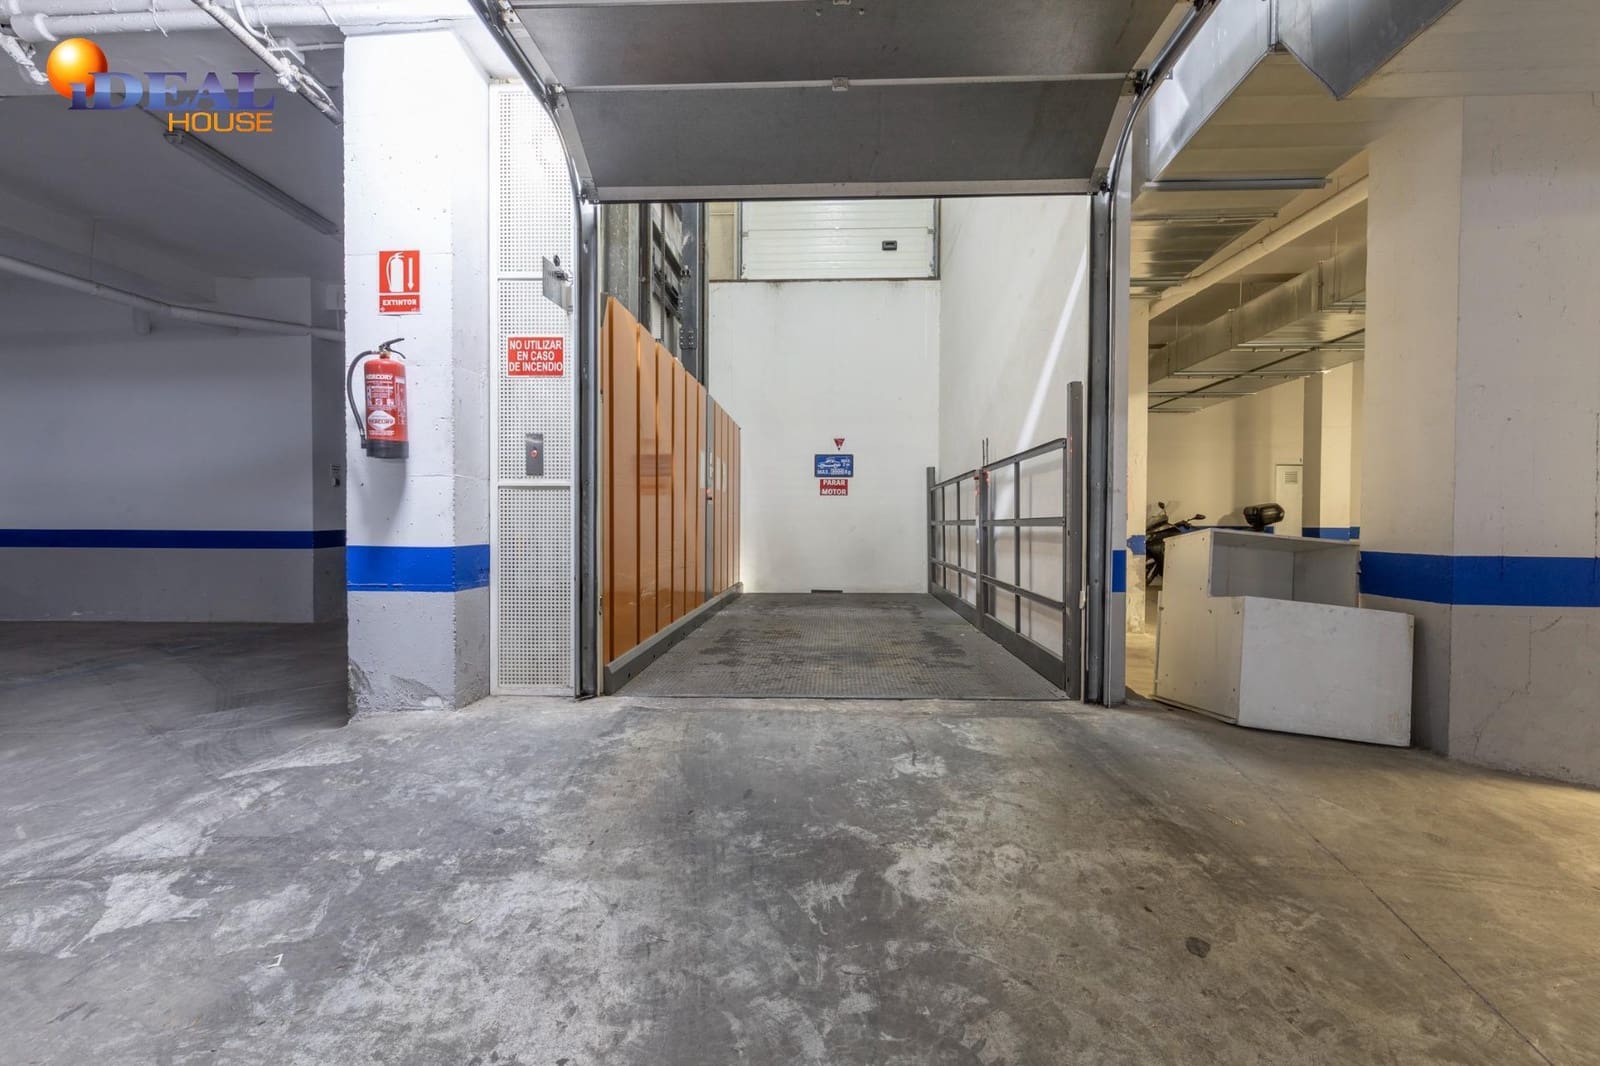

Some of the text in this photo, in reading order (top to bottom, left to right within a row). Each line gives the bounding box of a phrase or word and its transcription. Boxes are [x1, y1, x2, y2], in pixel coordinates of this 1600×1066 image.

[509, 340, 562, 350] NO UTILIZAR
[517, 351, 555, 361] EN CASO
[509, 362, 563, 372] DE INCENDIO
